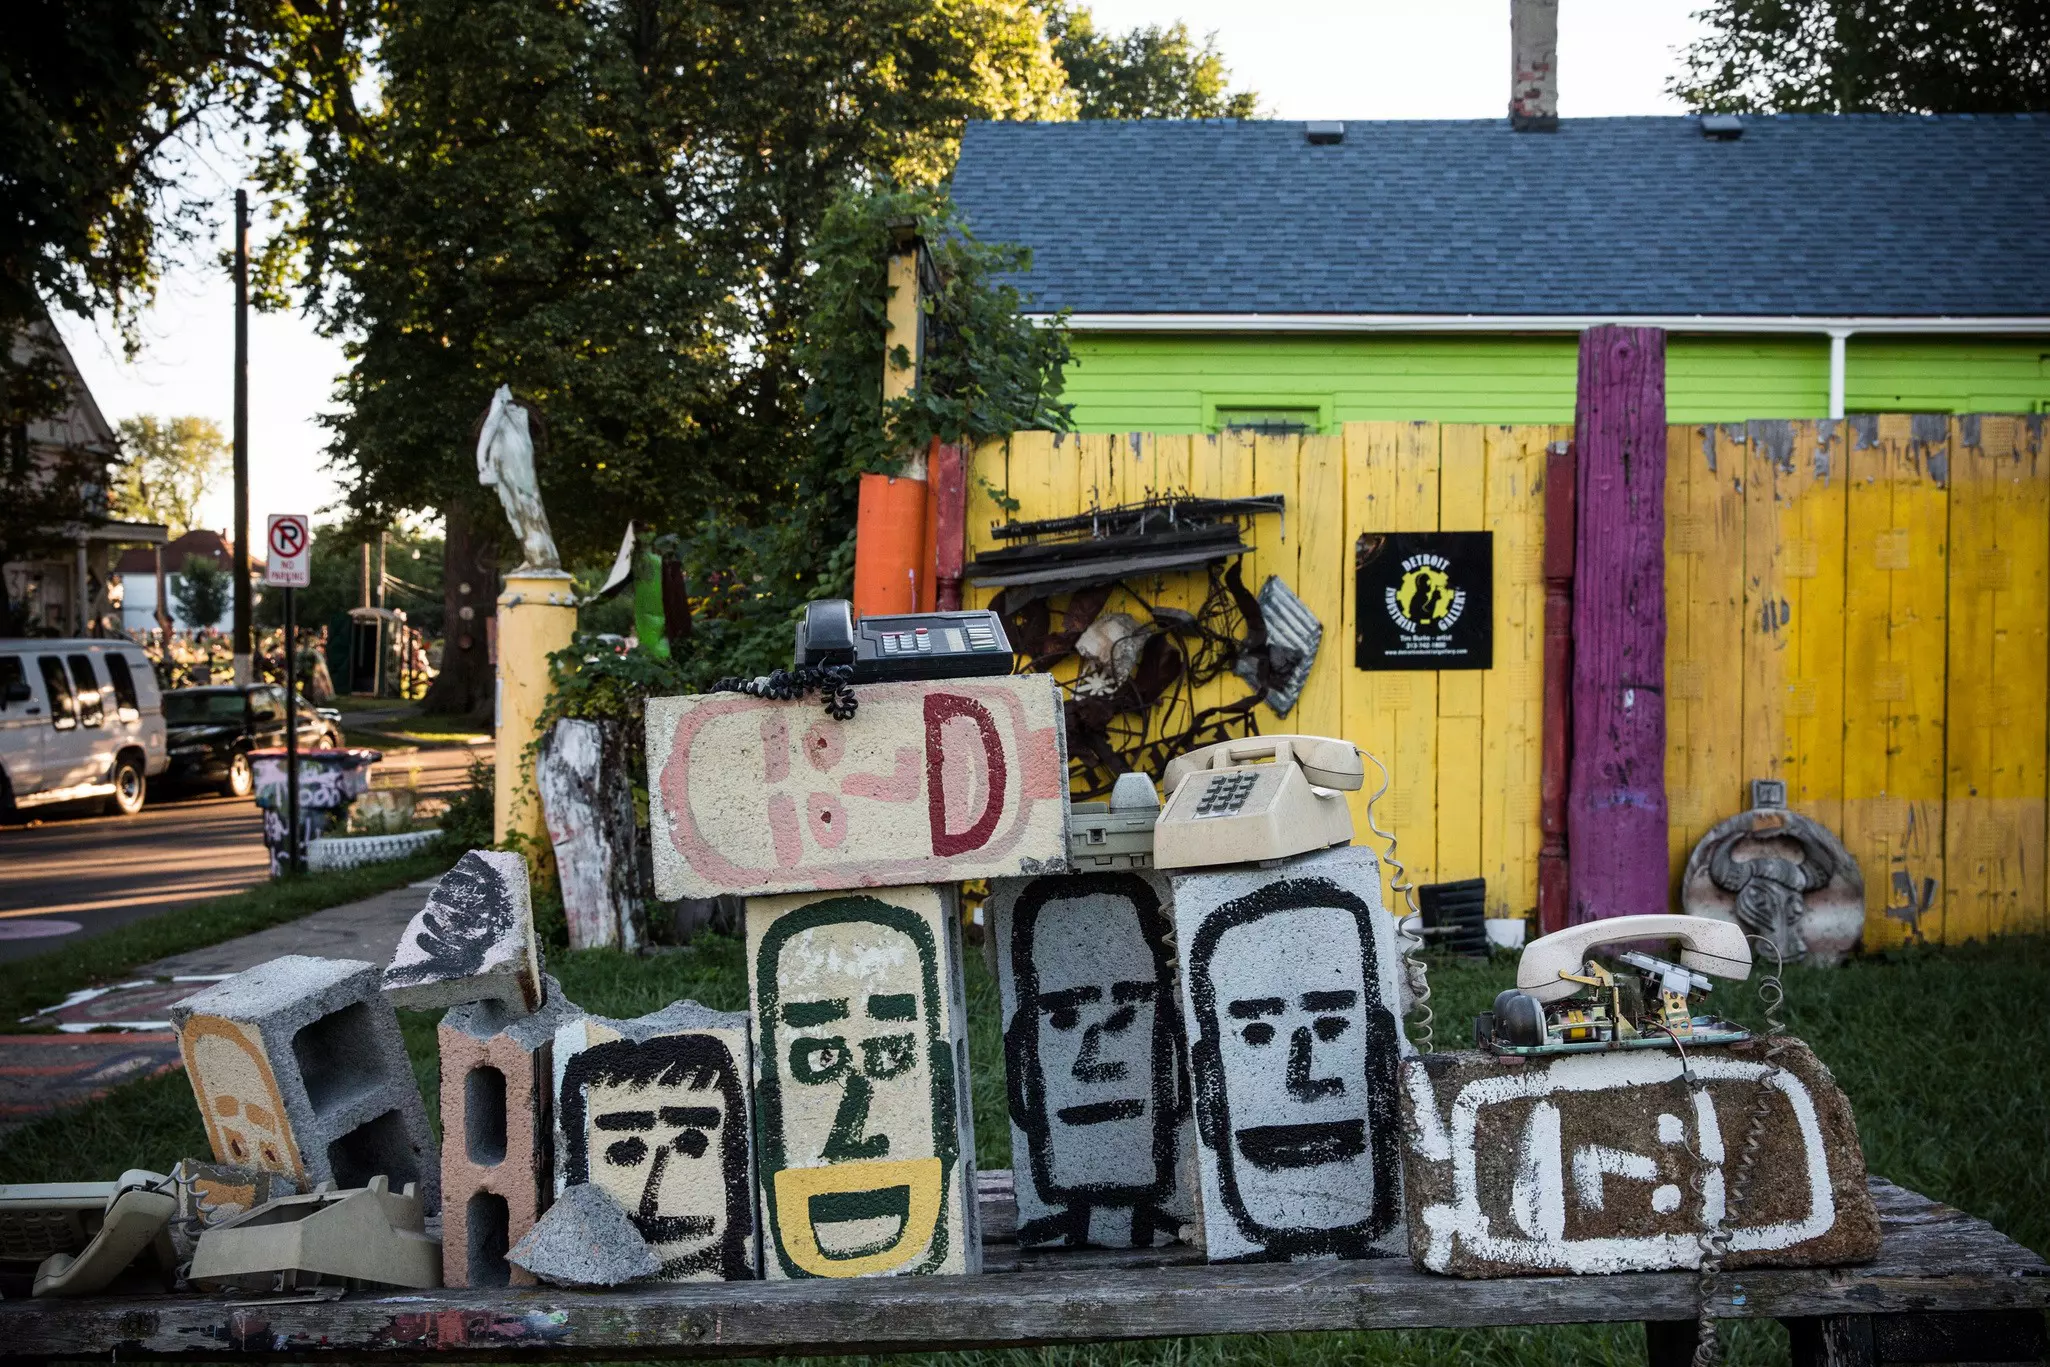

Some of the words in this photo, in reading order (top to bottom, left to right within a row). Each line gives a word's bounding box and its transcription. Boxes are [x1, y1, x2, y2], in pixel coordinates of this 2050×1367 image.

[281, 561, 295, 570] NO
[1401, 553, 1450, 572] DETROIT
[272, 571, 304, 580] PARKING
[1385, 587, 1417, 633] INDUSTRIAL
[1437, 590, 1466, 631] GALLERY
